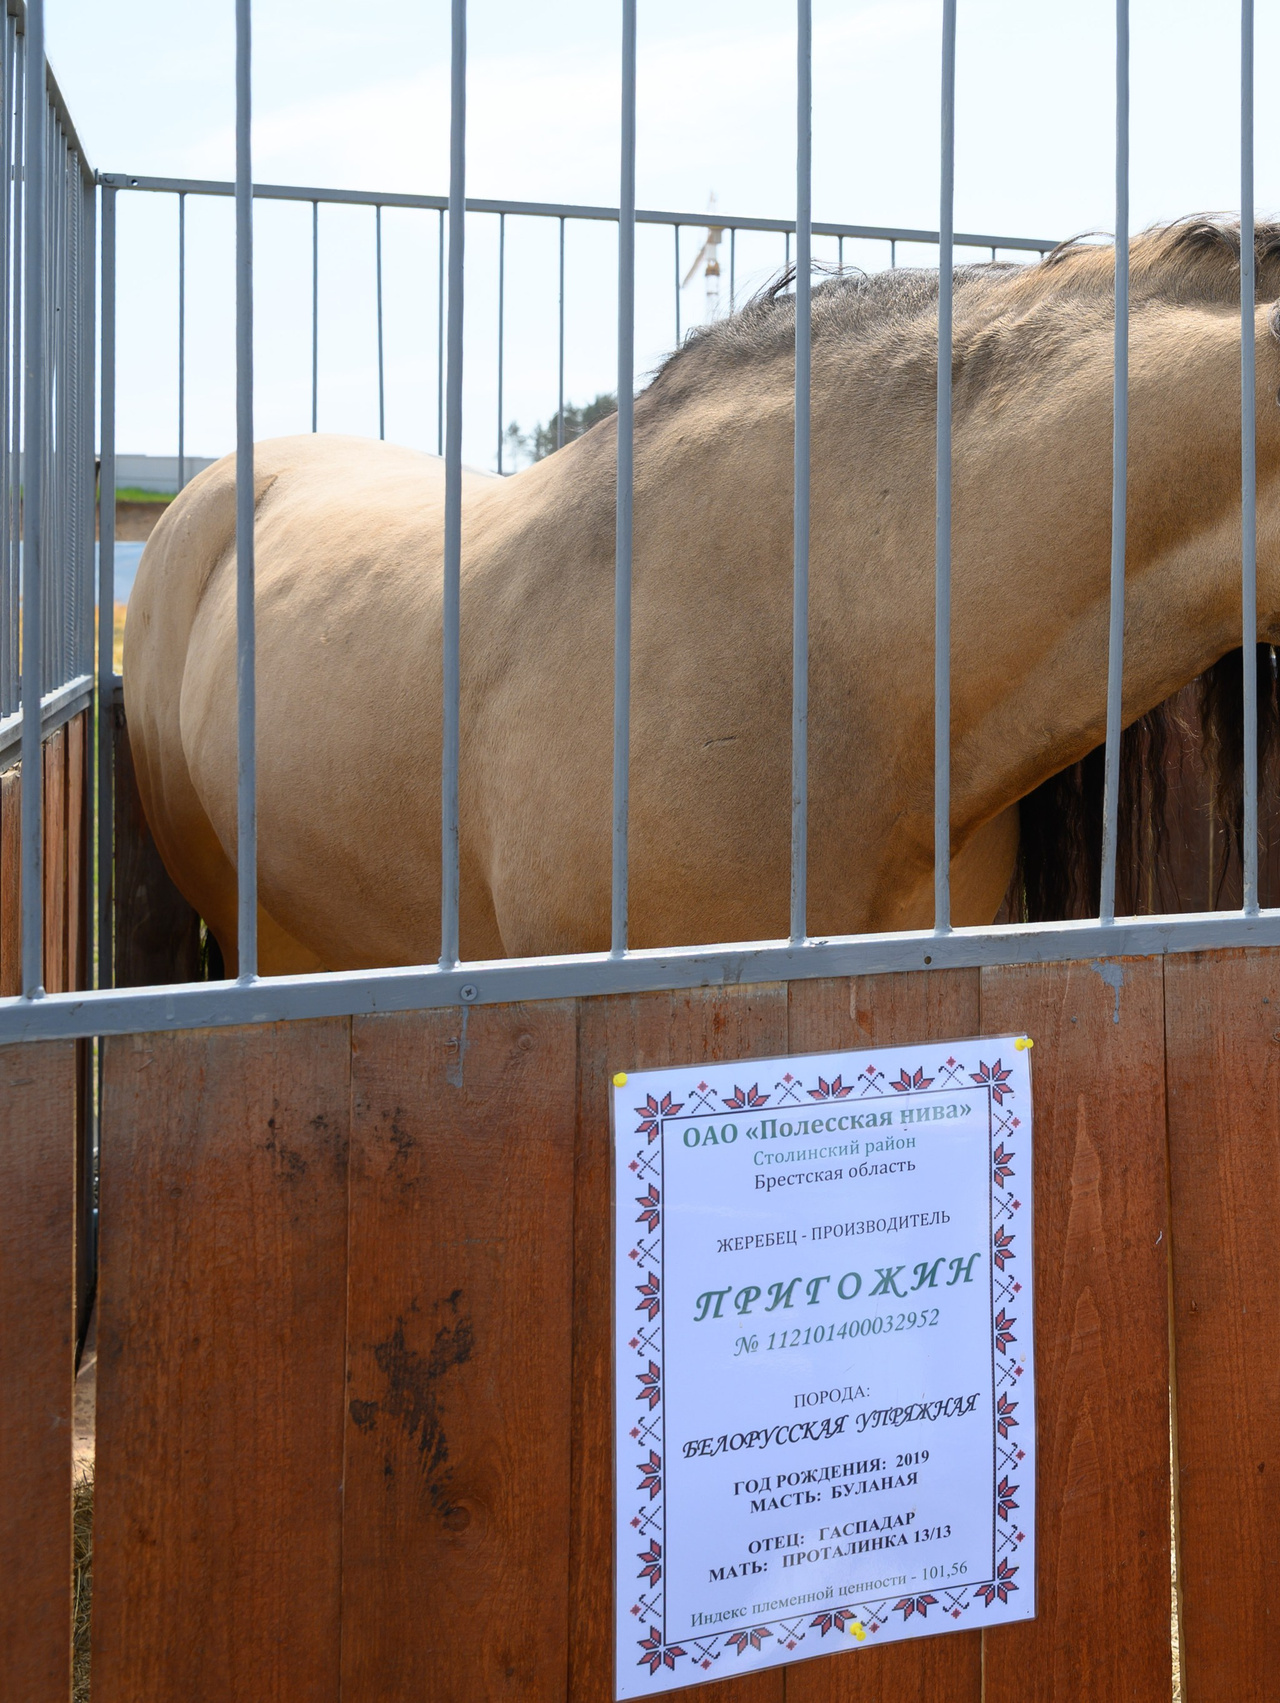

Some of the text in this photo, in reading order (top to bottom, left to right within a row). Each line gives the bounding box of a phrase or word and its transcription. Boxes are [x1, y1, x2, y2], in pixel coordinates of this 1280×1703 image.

[683, 1102, 972, 1148] ОАО «Полесская нива»
[753, 1136, 916, 1166] Столинский район
[754, 1159, 915, 1192] Брестская область
[717, 1229, 797, 1253] ЖЕРЕБЕЦ
[811, 1211, 951, 1242] ПРОИЗВОДИТЕЛЬ
[693, 1252, 982, 1322] ПРИГОЖИН
[733, 1308, 940, 1356] № 112101400032952
[794, 1385, 870, 1408] ПОРОДА:
[682, 1393, 981, 1458] БЕЛОРУССКАЯ УПРЯЖНАЯ
[734, 1450, 930, 1496] ГОД РОЖДЕНИЯ: 2019
[750, 1472, 919, 1513] МАСТЬ: БУЛАНАЯ
[708, 1525, 952, 1582] МАТЬ: ПРОТАЛИНКА 13/13
[748, 1511, 915, 1555] ОТЕЦ: ГАСПАДАР
[691, 1606, 747, 1628] Индекс
[752, 1585, 834, 1617] племенной
[838, 1572, 907, 1597] ценности
[922, 1561, 968, 1582] 101,56
